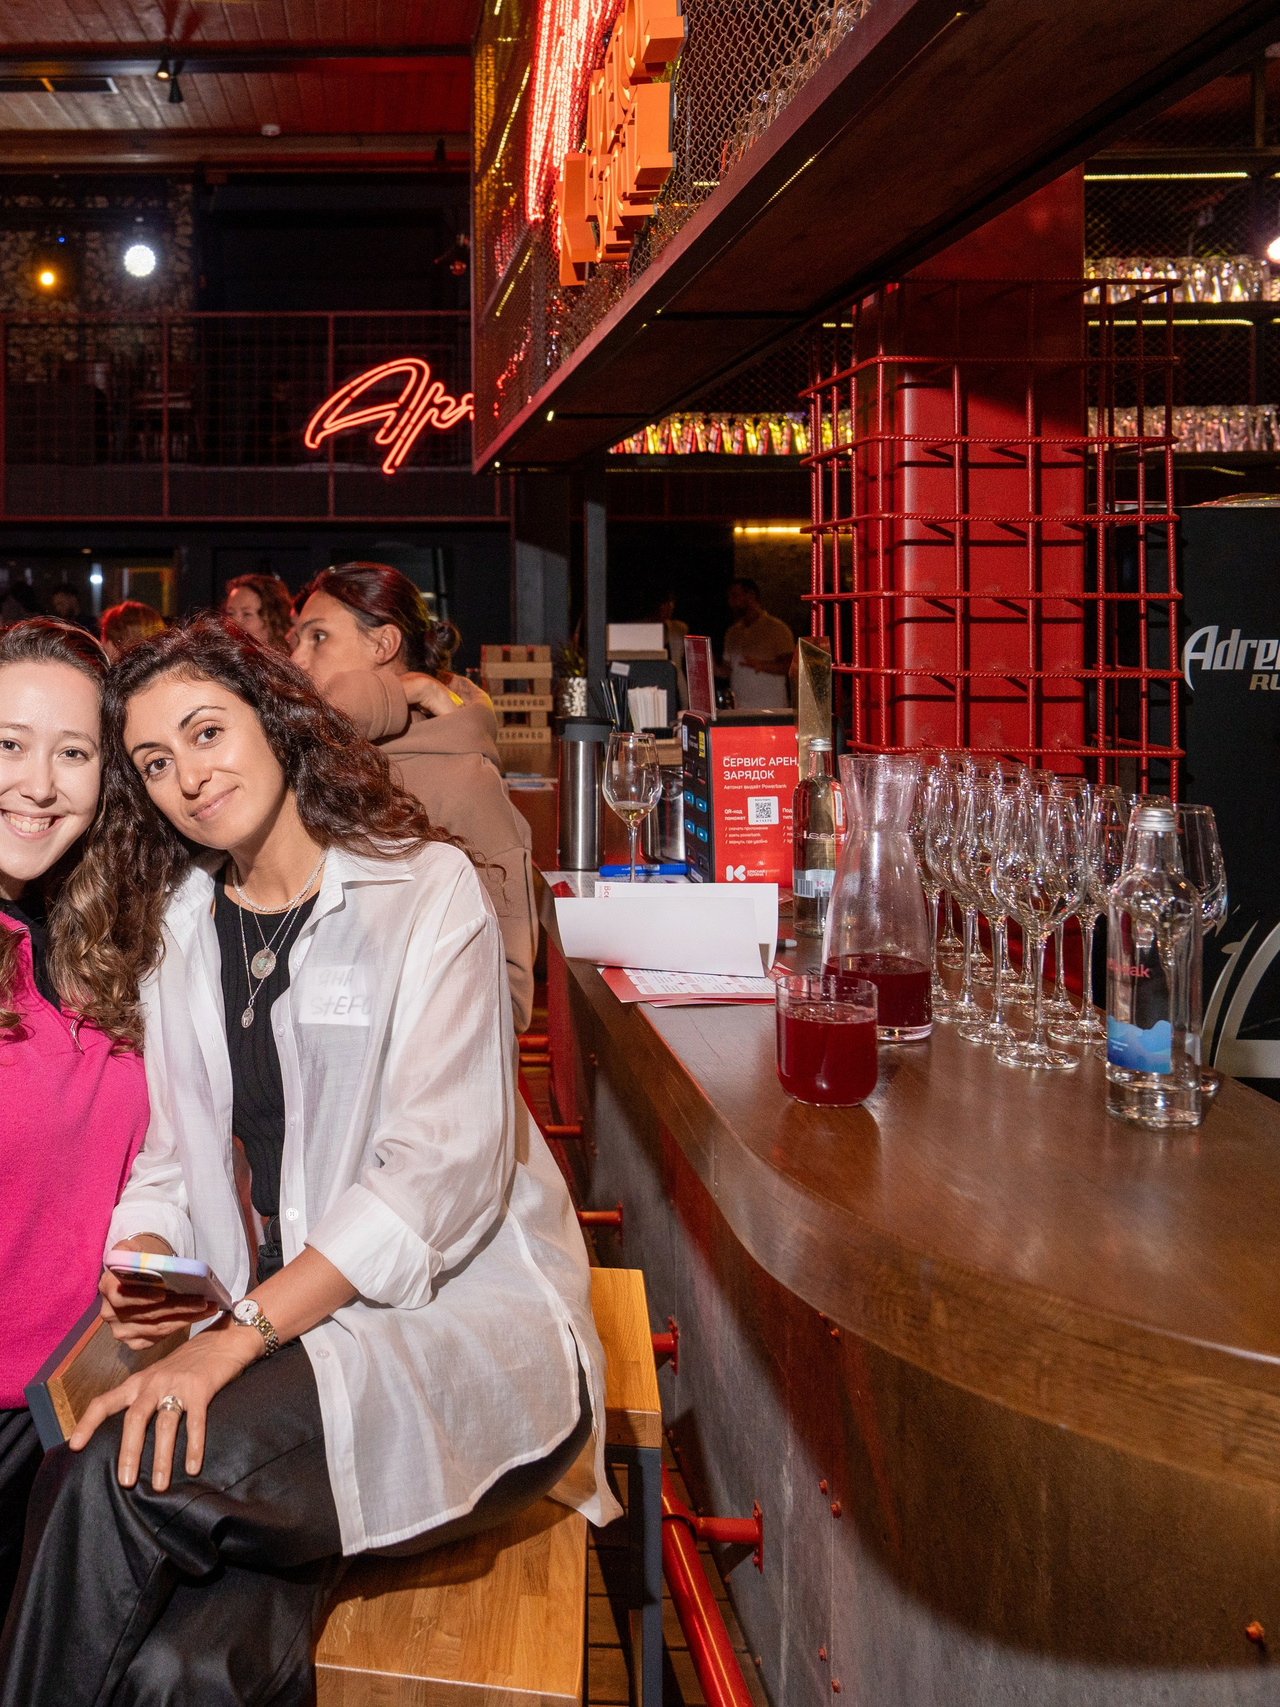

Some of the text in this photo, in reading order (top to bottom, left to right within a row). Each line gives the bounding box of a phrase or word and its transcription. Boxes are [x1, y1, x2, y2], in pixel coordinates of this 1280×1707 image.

[1182, 625, 1280, 691] Adre
[499, 731, 544, 739] ESERVED
[723, 756, 799, 768] СЕРВИС АРЕН
[723, 770, 775, 781] ЗАРЯДОК
